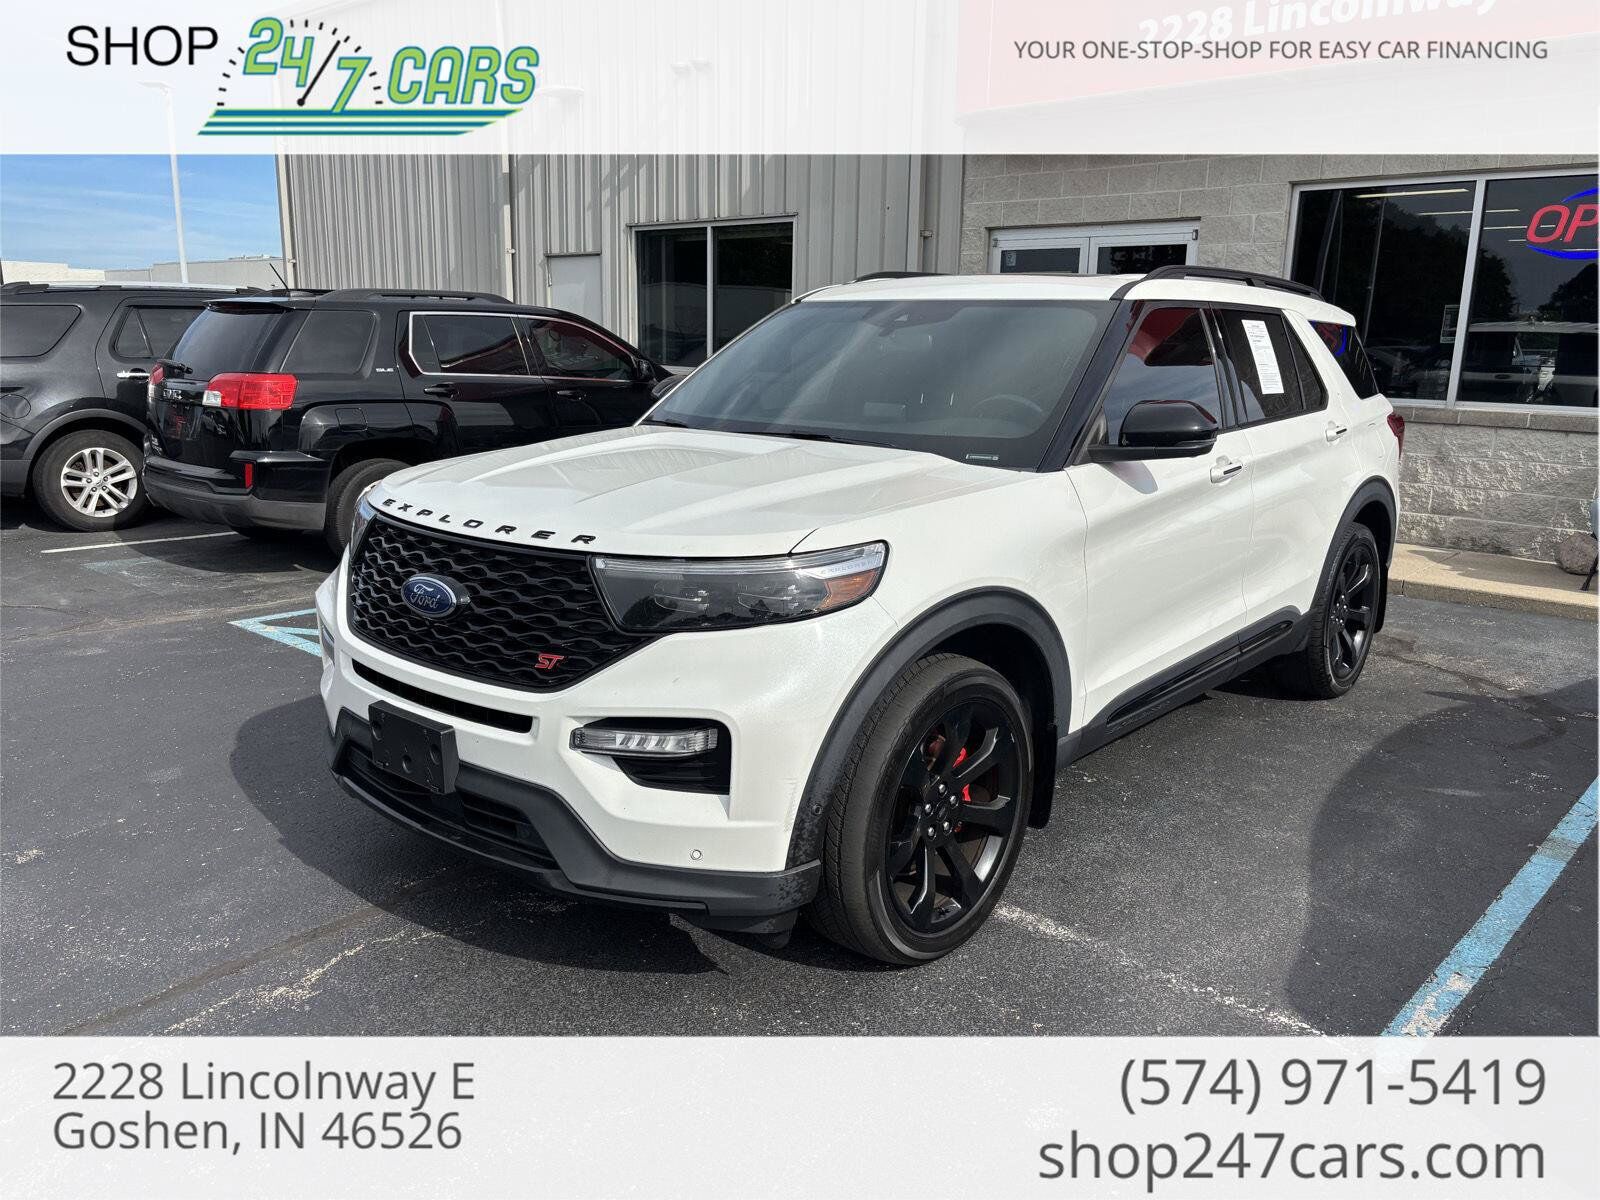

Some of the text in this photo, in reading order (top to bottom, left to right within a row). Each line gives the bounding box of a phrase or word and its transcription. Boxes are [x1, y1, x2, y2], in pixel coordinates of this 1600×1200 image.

[1242, 0, 1494, 37] Linco
[1526, 204, 1599, 244] OP
[382, 498, 597, 545] EXPLORER
[408, 583, 441, 610] Ford
[534, 653, 565, 670] ST
